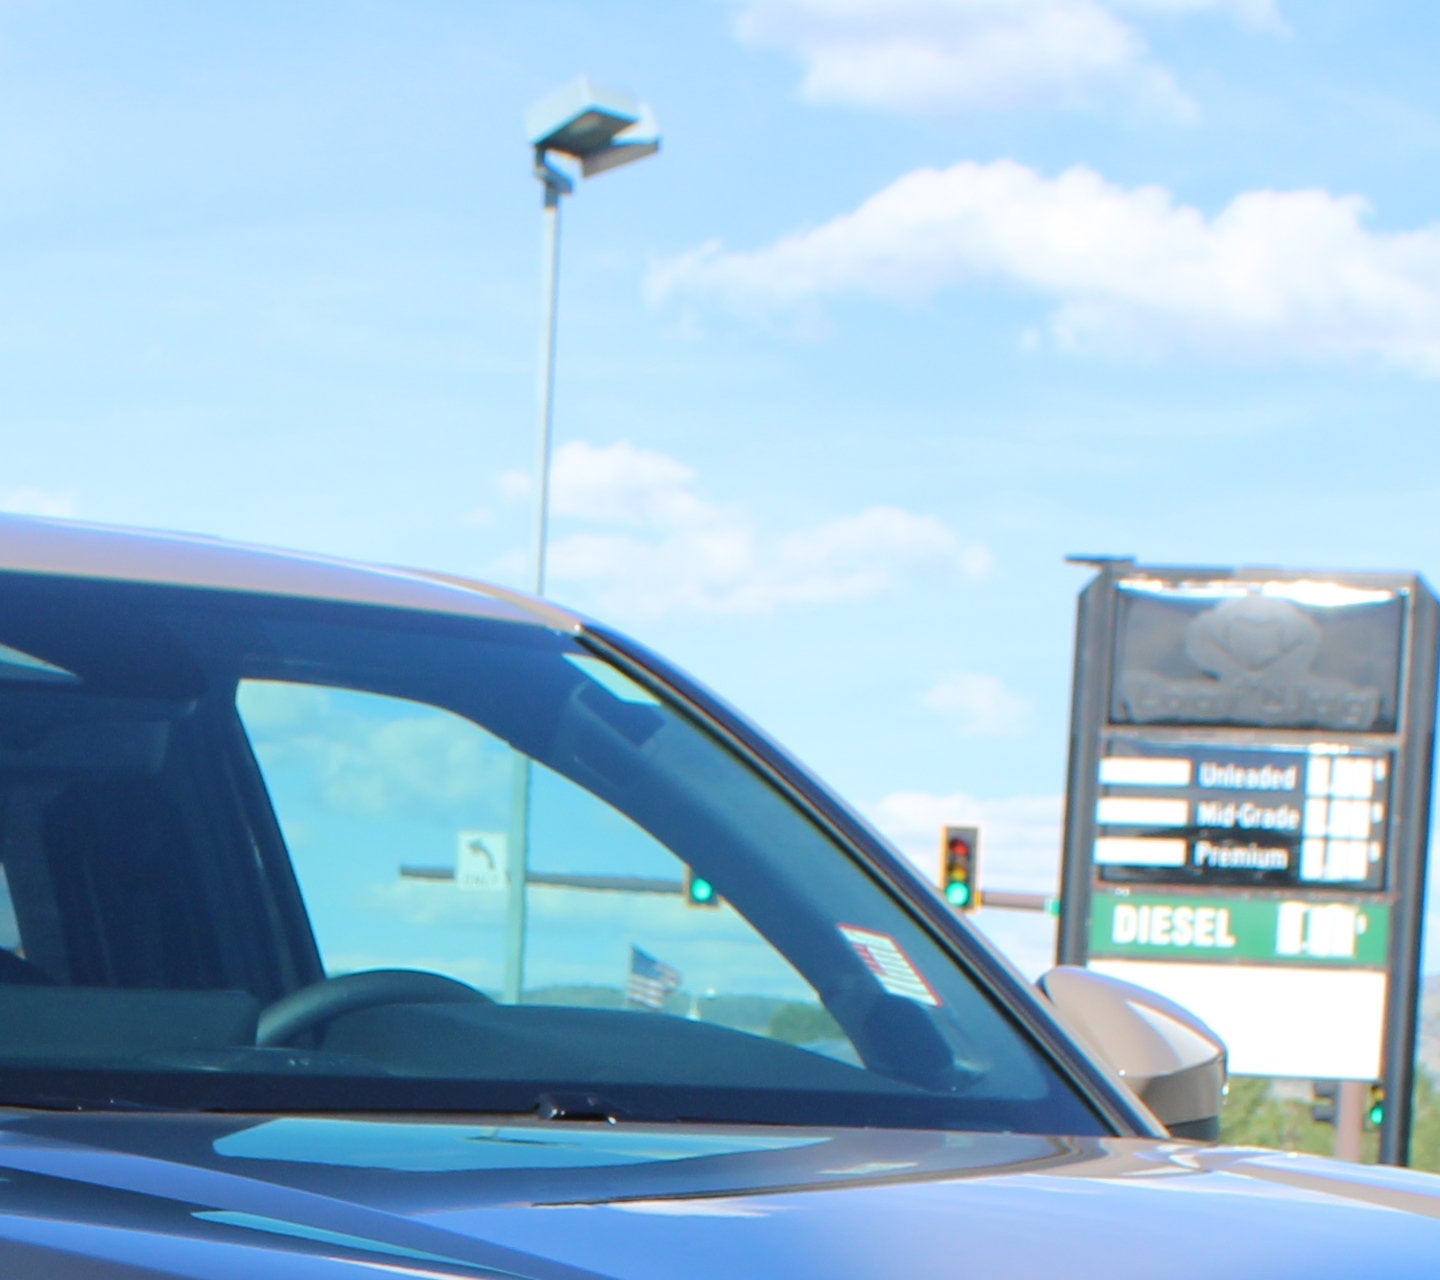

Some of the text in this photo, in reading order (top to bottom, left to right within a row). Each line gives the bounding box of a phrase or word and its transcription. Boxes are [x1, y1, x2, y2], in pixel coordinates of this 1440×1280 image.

[1199, 761, 1297, 791] Unleaded
[1196, 800, 1301, 829] Mid-Grade
[1193, 839, 1290, 870] Premium
[1112, 904, 1236, 947] DIESEL
